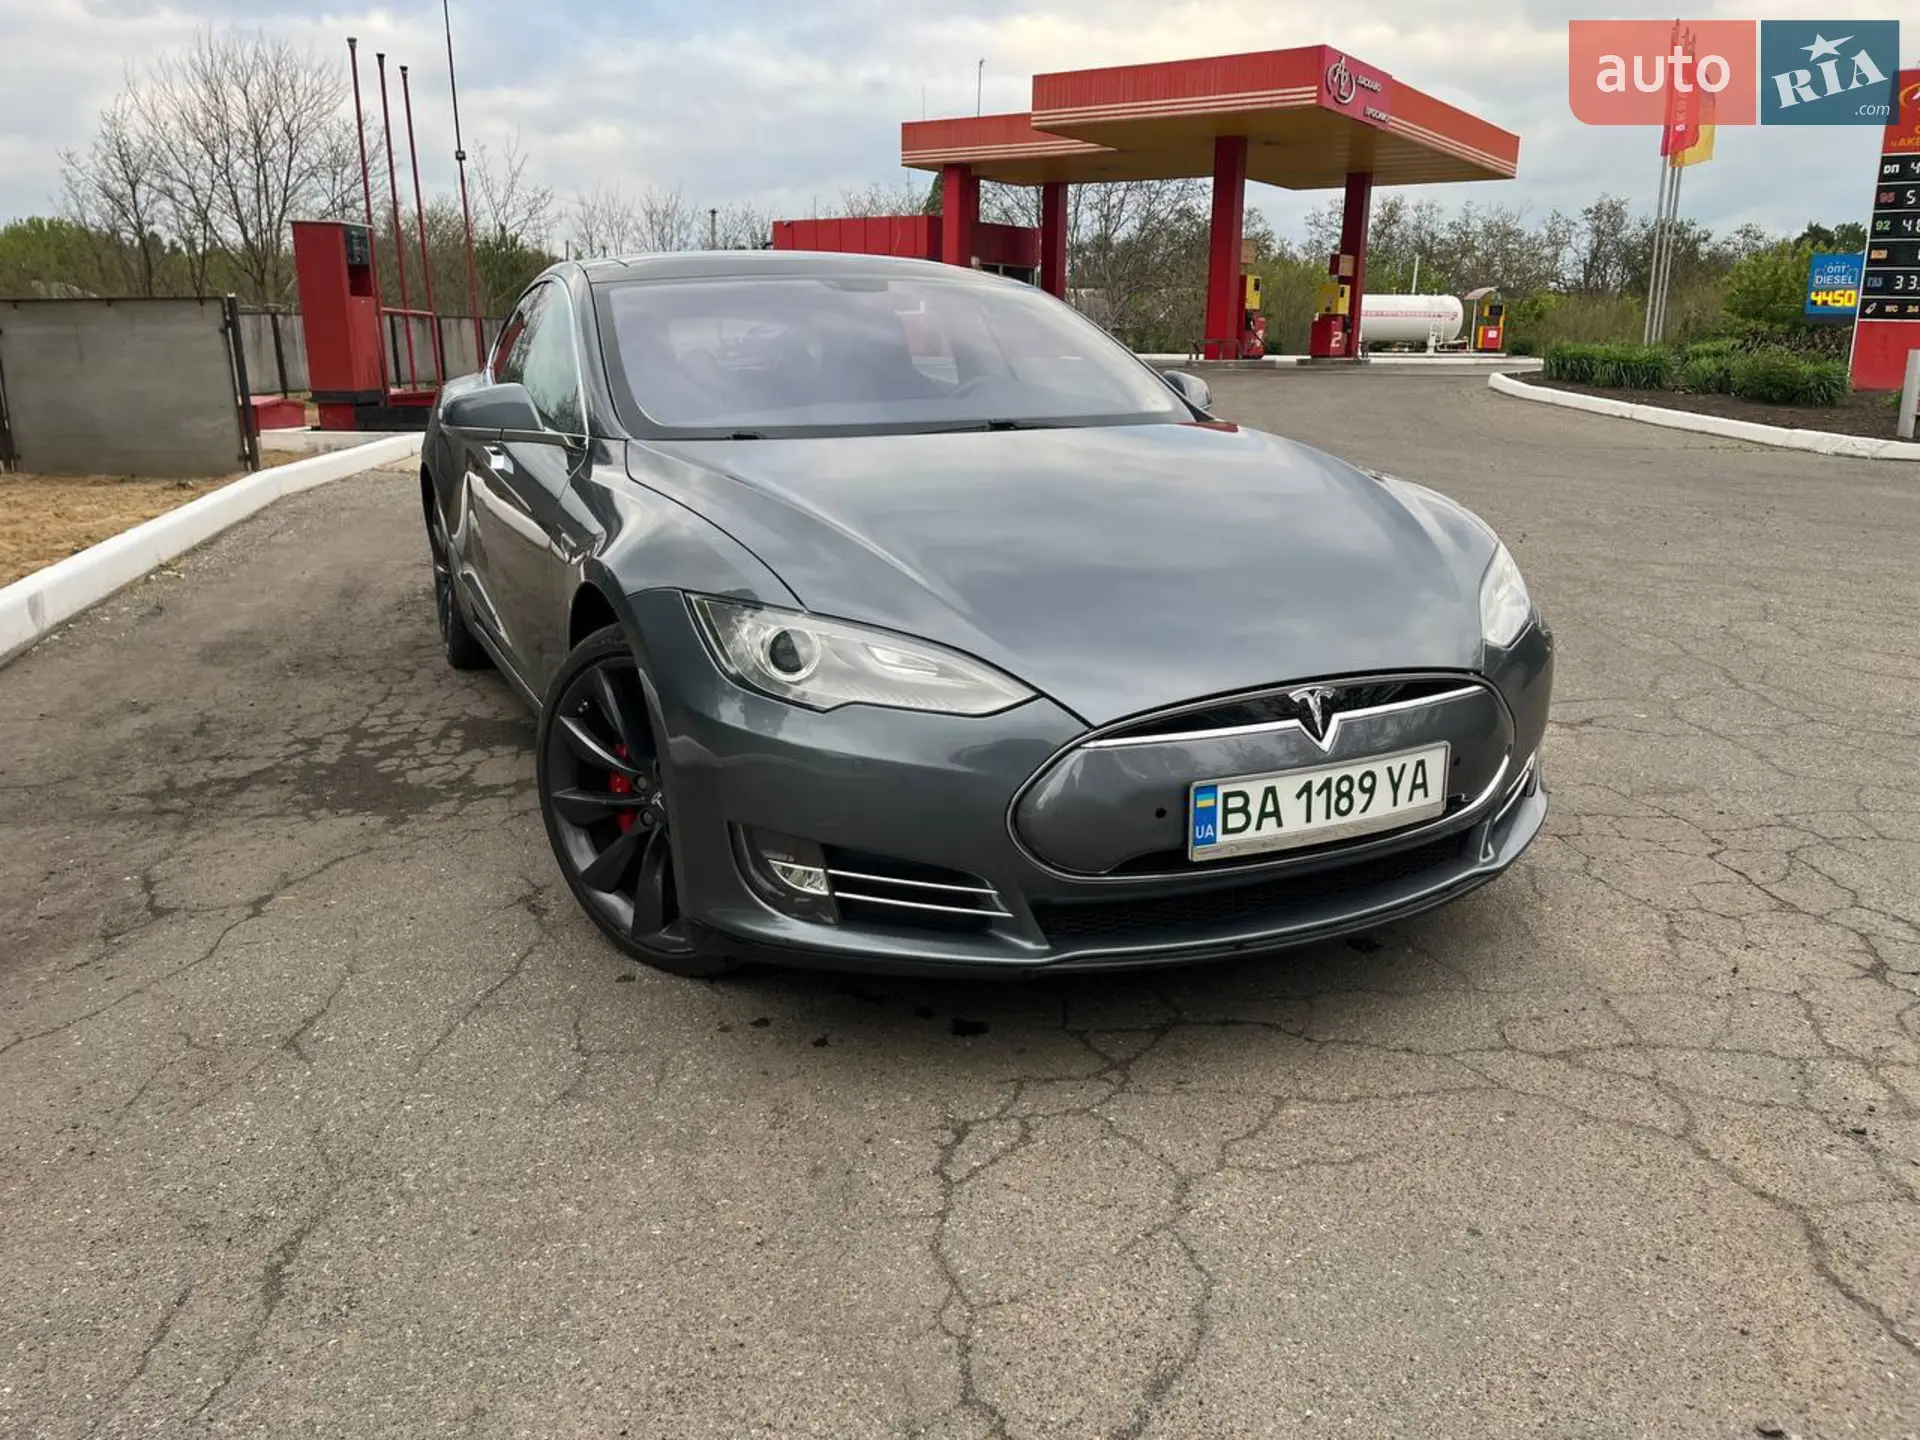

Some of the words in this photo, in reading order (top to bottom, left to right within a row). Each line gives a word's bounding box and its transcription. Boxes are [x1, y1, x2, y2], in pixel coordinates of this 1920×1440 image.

[1875, 220, 1891, 231] 92
[1815, 275, 1854, 285] DIESEL
[1811, 290, 1857, 307] 4450
[1330, 331, 1343, 348] 2
[1221, 785, 1283, 836] BA
[1295, 770, 1377, 823] 1189
[1387, 759, 1429, 807] YA
[1195, 824, 1214, 839] UA
